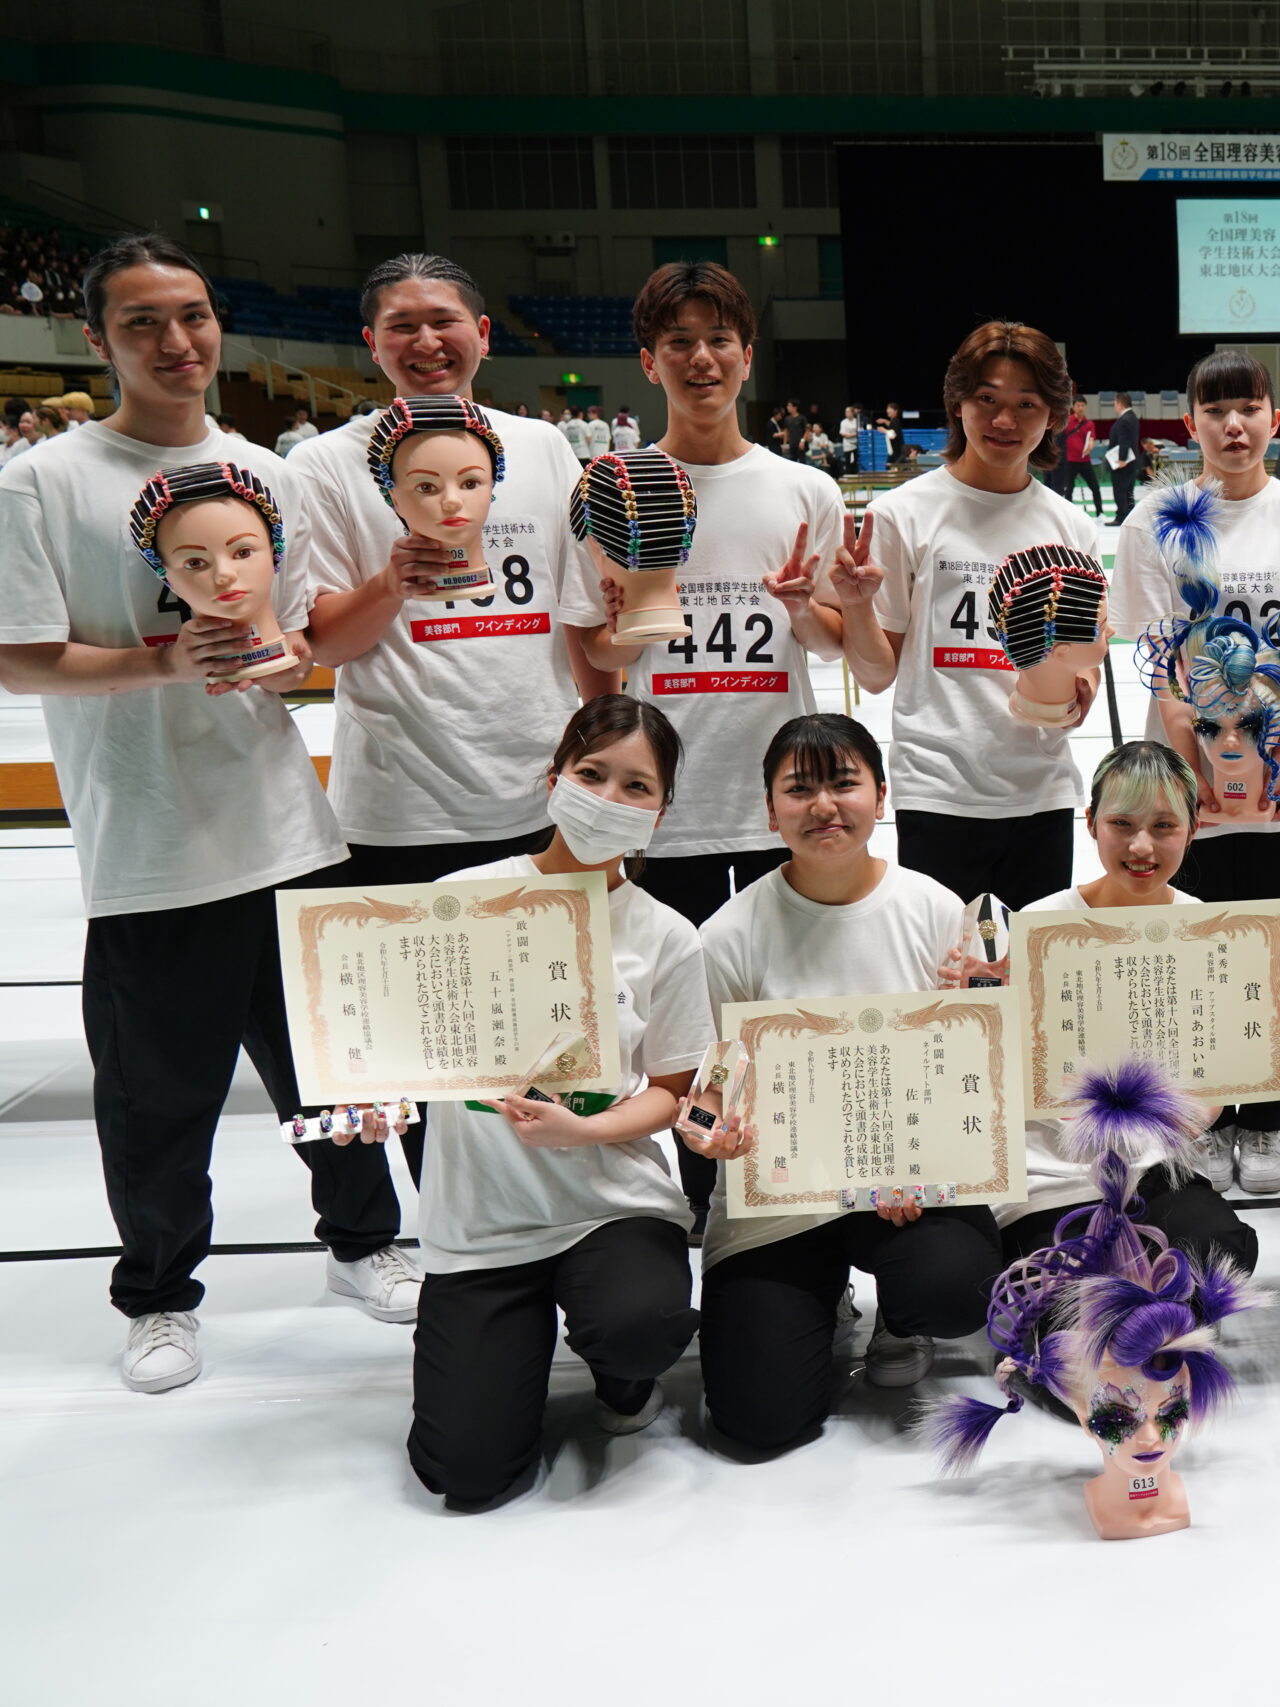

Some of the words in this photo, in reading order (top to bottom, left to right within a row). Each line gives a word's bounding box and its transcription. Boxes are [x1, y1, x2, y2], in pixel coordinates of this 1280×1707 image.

[1207, 228, 1276, 243] 全国理美容
[1223, 211, 1258, 224] 第18回
[483, 522, 536, 536] 学生技術大会
[487, 536, 515, 549] 大会
[938, 560, 998, 574] 第18回全国理容
[680, 594, 760, 606] 東北地区大会
[424, 623, 461, 636] 美容部門
[475, 618, 541, 632] ワインディング
[667, 612, 774, 664] 442
[943, 653, 975, 663] 美容部門
[663, 678, 696, 689] 美容部門
[710, 676, 778, 688] ワインディング
[1227, 782, 1244, 791] 602
[400, 936, 411, 961] ます
[516, 920, 530, 963] 敢闘賞
[1114, 956, 1125, 980] ます
[1218, 943, 1229, 984] 優秀賞
[413, 935, 433, 1070] 収められたのでこれを賞し
[430, 934, 449, 1070] 大会において頭書の成績を
[444, 933, 464, 1069] 美容学生技術大会東北地区
[457, 932, 478, 1067] あなたは第十八回全国理容
[548, 961, 572, 1022] 賞状
[1244, 982, 1262, 1040] 賞状
[933, 1033, 945, 1075] 敢闘賞
[1190, 988, 1205, 1079] 庄司あおい殿
[827, 1047, 838, 1071] ます
[923, 1041, 932, 1105] ネイルアート部門
[840, 1046, 854, 1179] 収められたのでこれを賞し
[854, 1045, 868, 1178] 大会において頭書の成績を
[868, 1045, 882, 1177] 美容学生技術大会東北地区
[880, 1044, 895, 1176] あなたは第十八回全国理容
[961, 1074, 982, 1135] 賞状
[1133, 1477, 1154, 1489] 613
